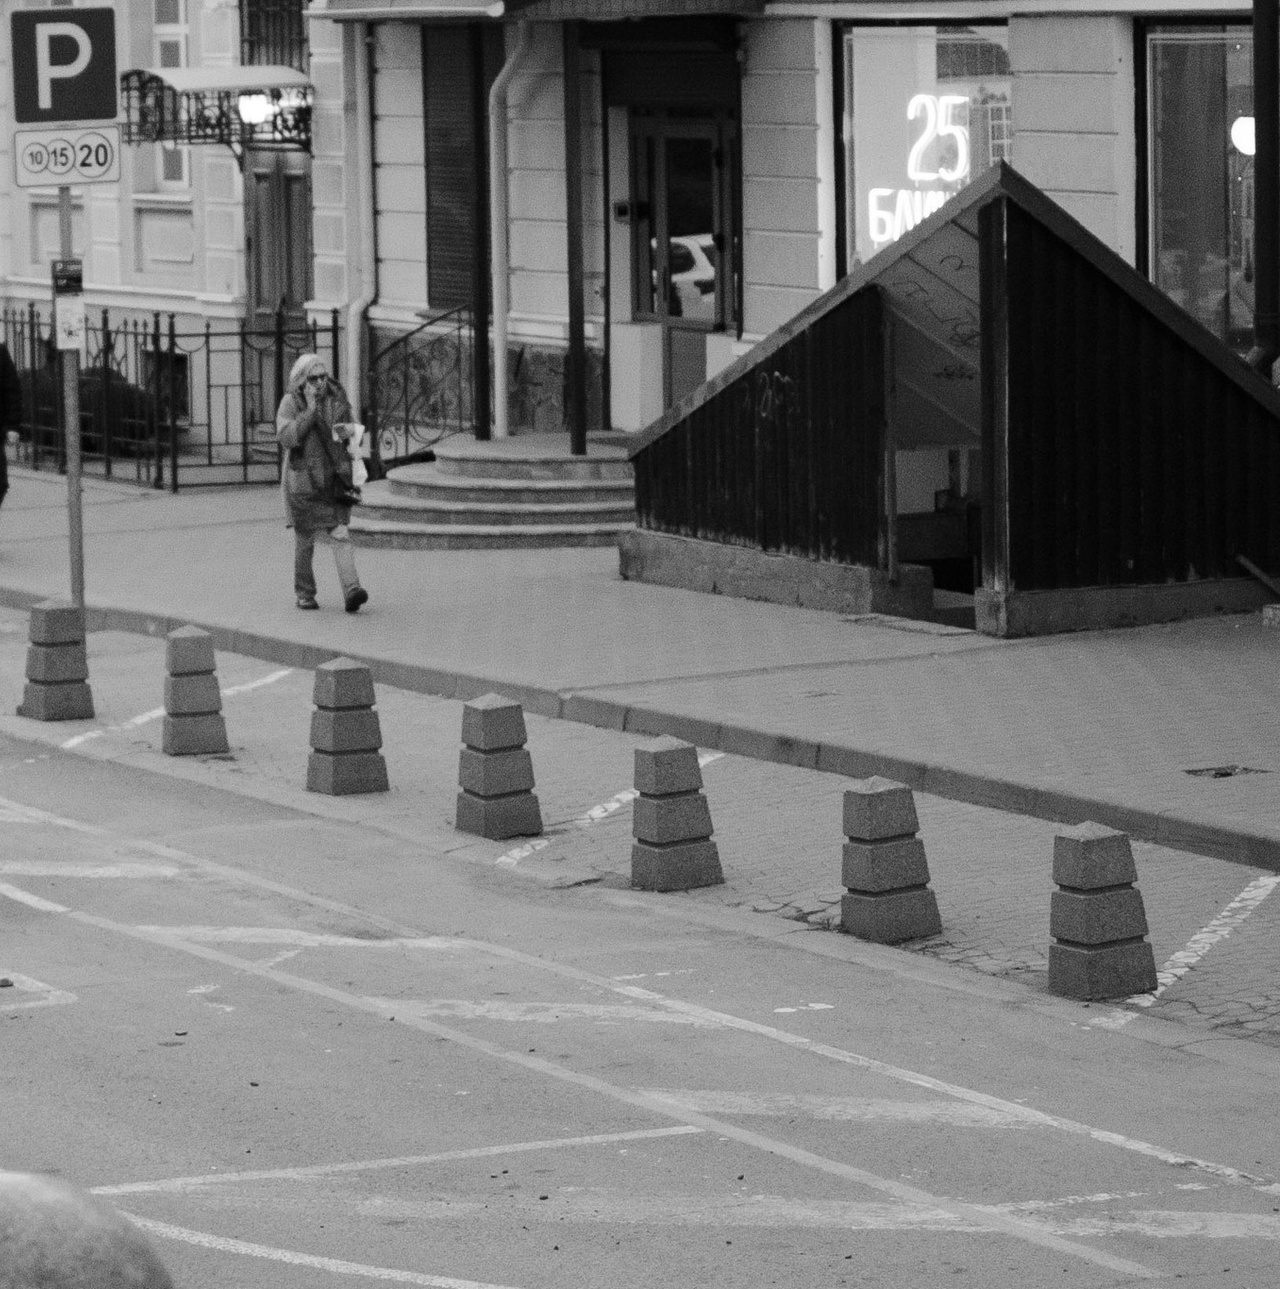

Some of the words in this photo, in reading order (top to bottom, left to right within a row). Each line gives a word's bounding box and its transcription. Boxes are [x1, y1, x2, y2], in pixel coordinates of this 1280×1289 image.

[35, 22, 92, 109] P
[29, 150, 43, 165] 10
[51, 147, 69, 166] 15
[79, 143, 108, 167] 20
[907, 94, 969, 181] 25
